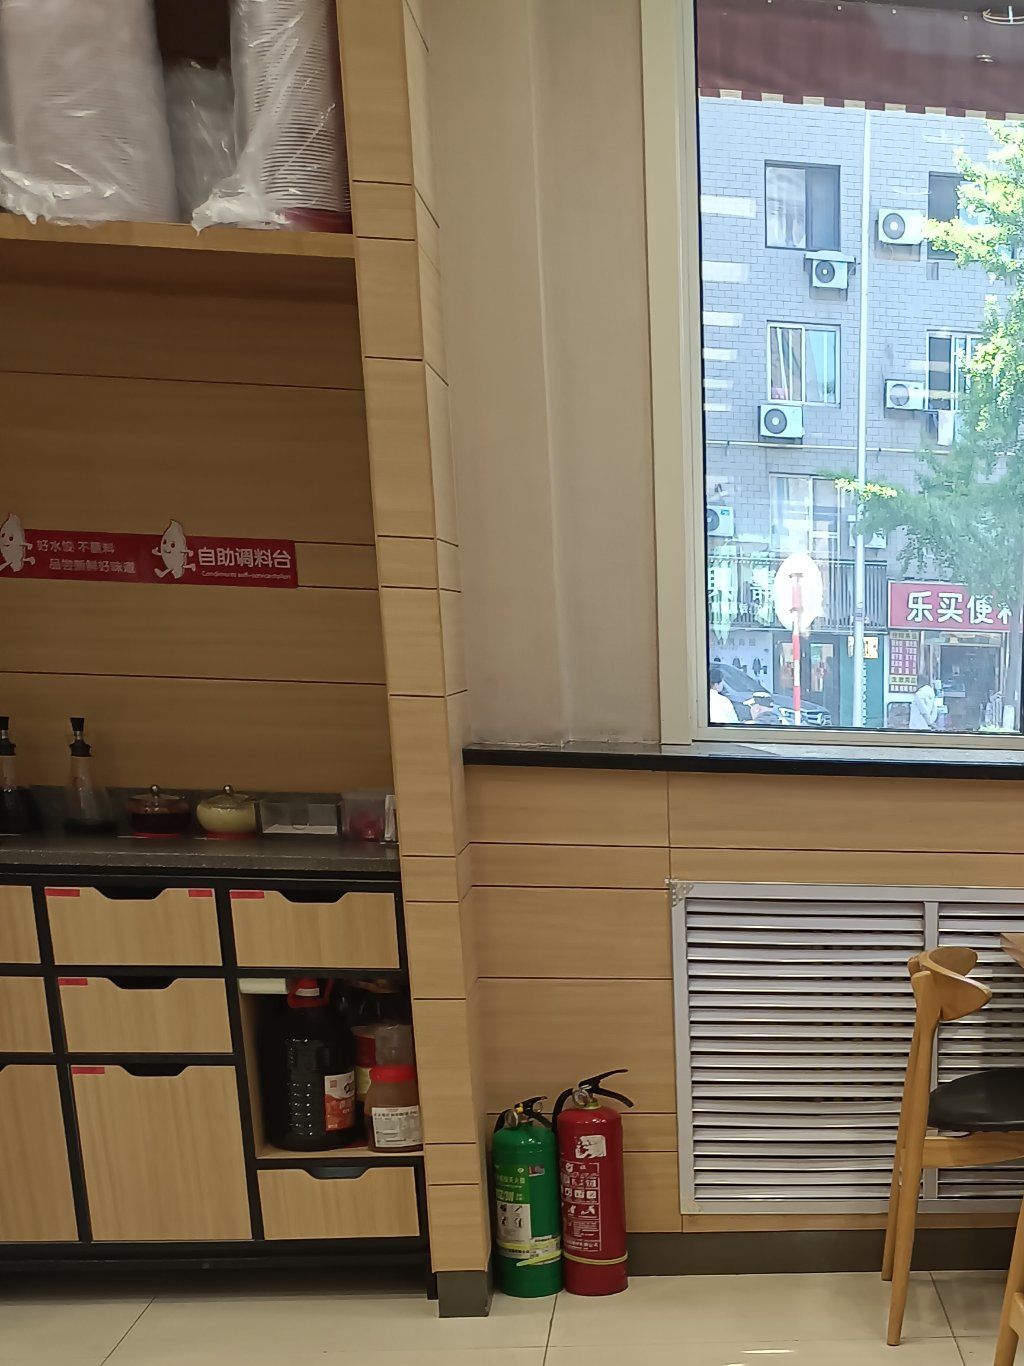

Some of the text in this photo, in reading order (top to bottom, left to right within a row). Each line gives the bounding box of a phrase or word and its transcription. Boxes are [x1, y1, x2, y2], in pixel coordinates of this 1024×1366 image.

[198, 546, 291, 568] 自助调料台
